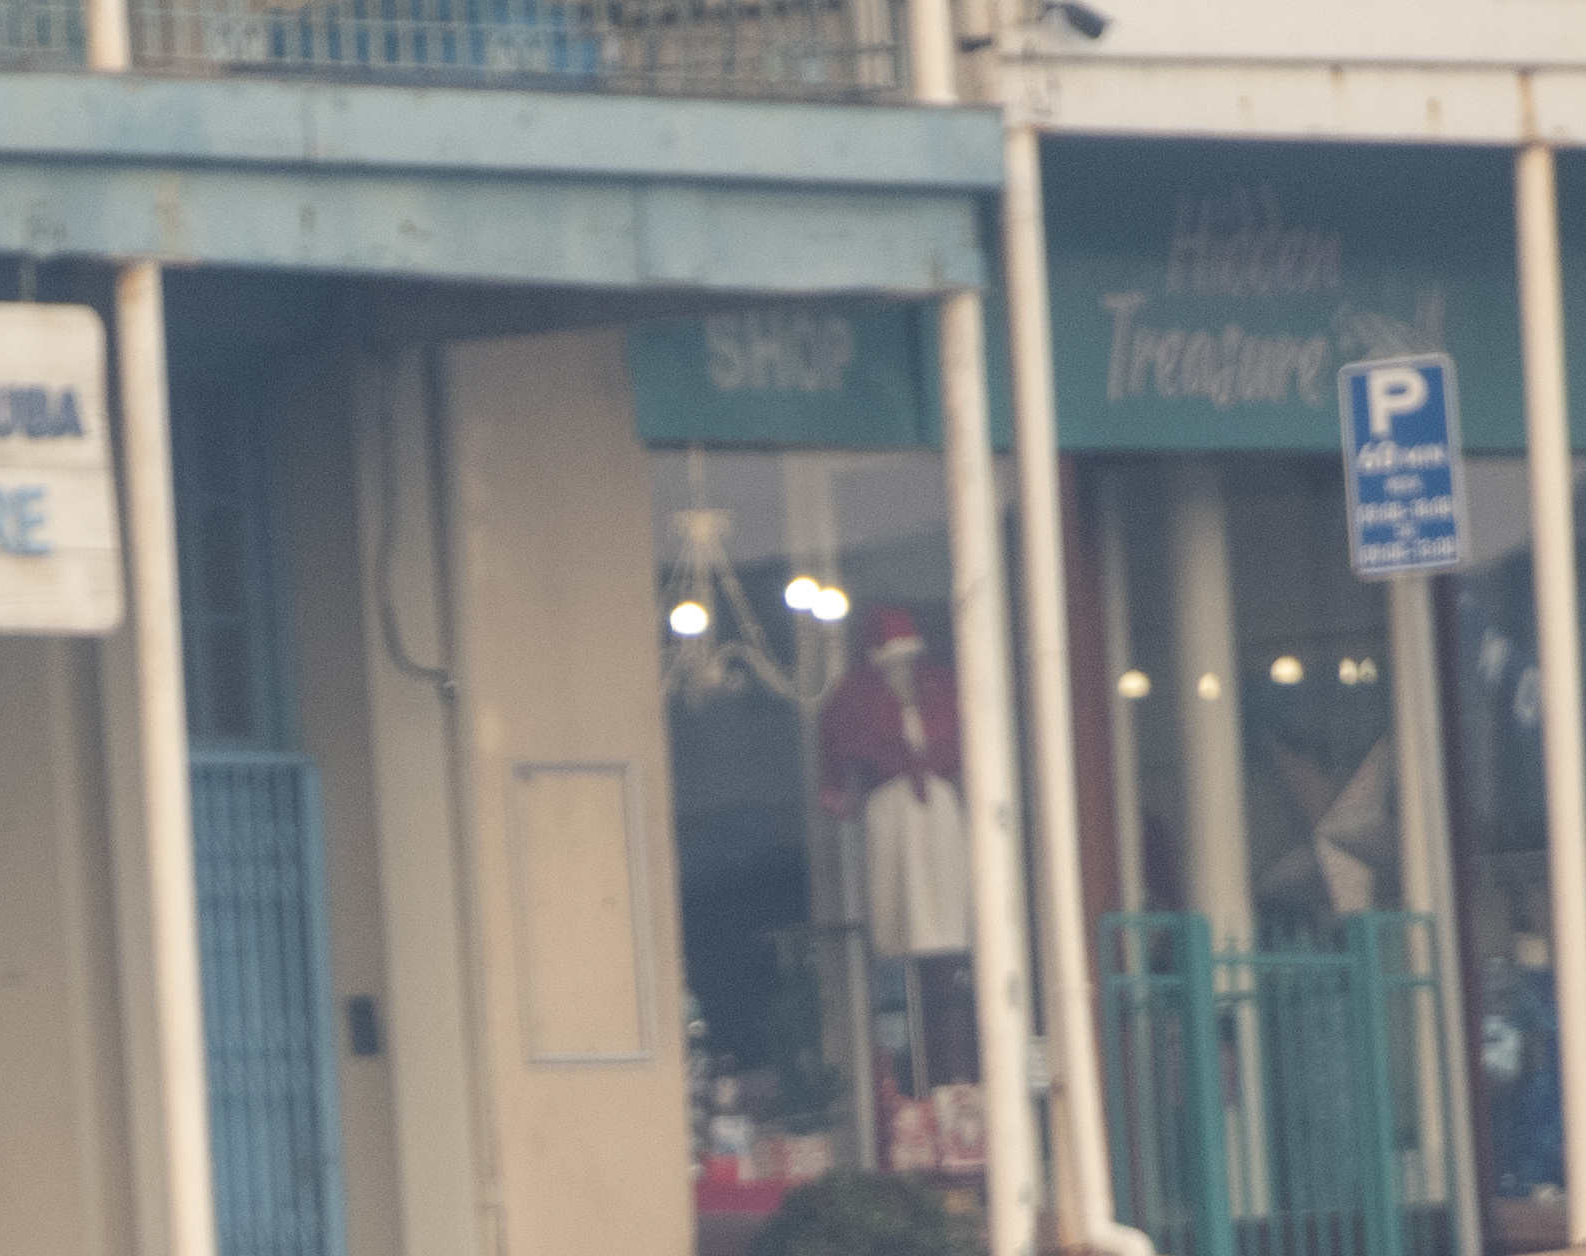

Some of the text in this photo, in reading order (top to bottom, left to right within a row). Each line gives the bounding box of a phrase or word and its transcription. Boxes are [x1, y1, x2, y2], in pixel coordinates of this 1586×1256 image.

[1166, 186, 1341, 296] Hidden
[705, 315, 853, 390] SHOP
[1105, 294, 1327, 405] Treasure
[1367, 367, 1427, 437] P
